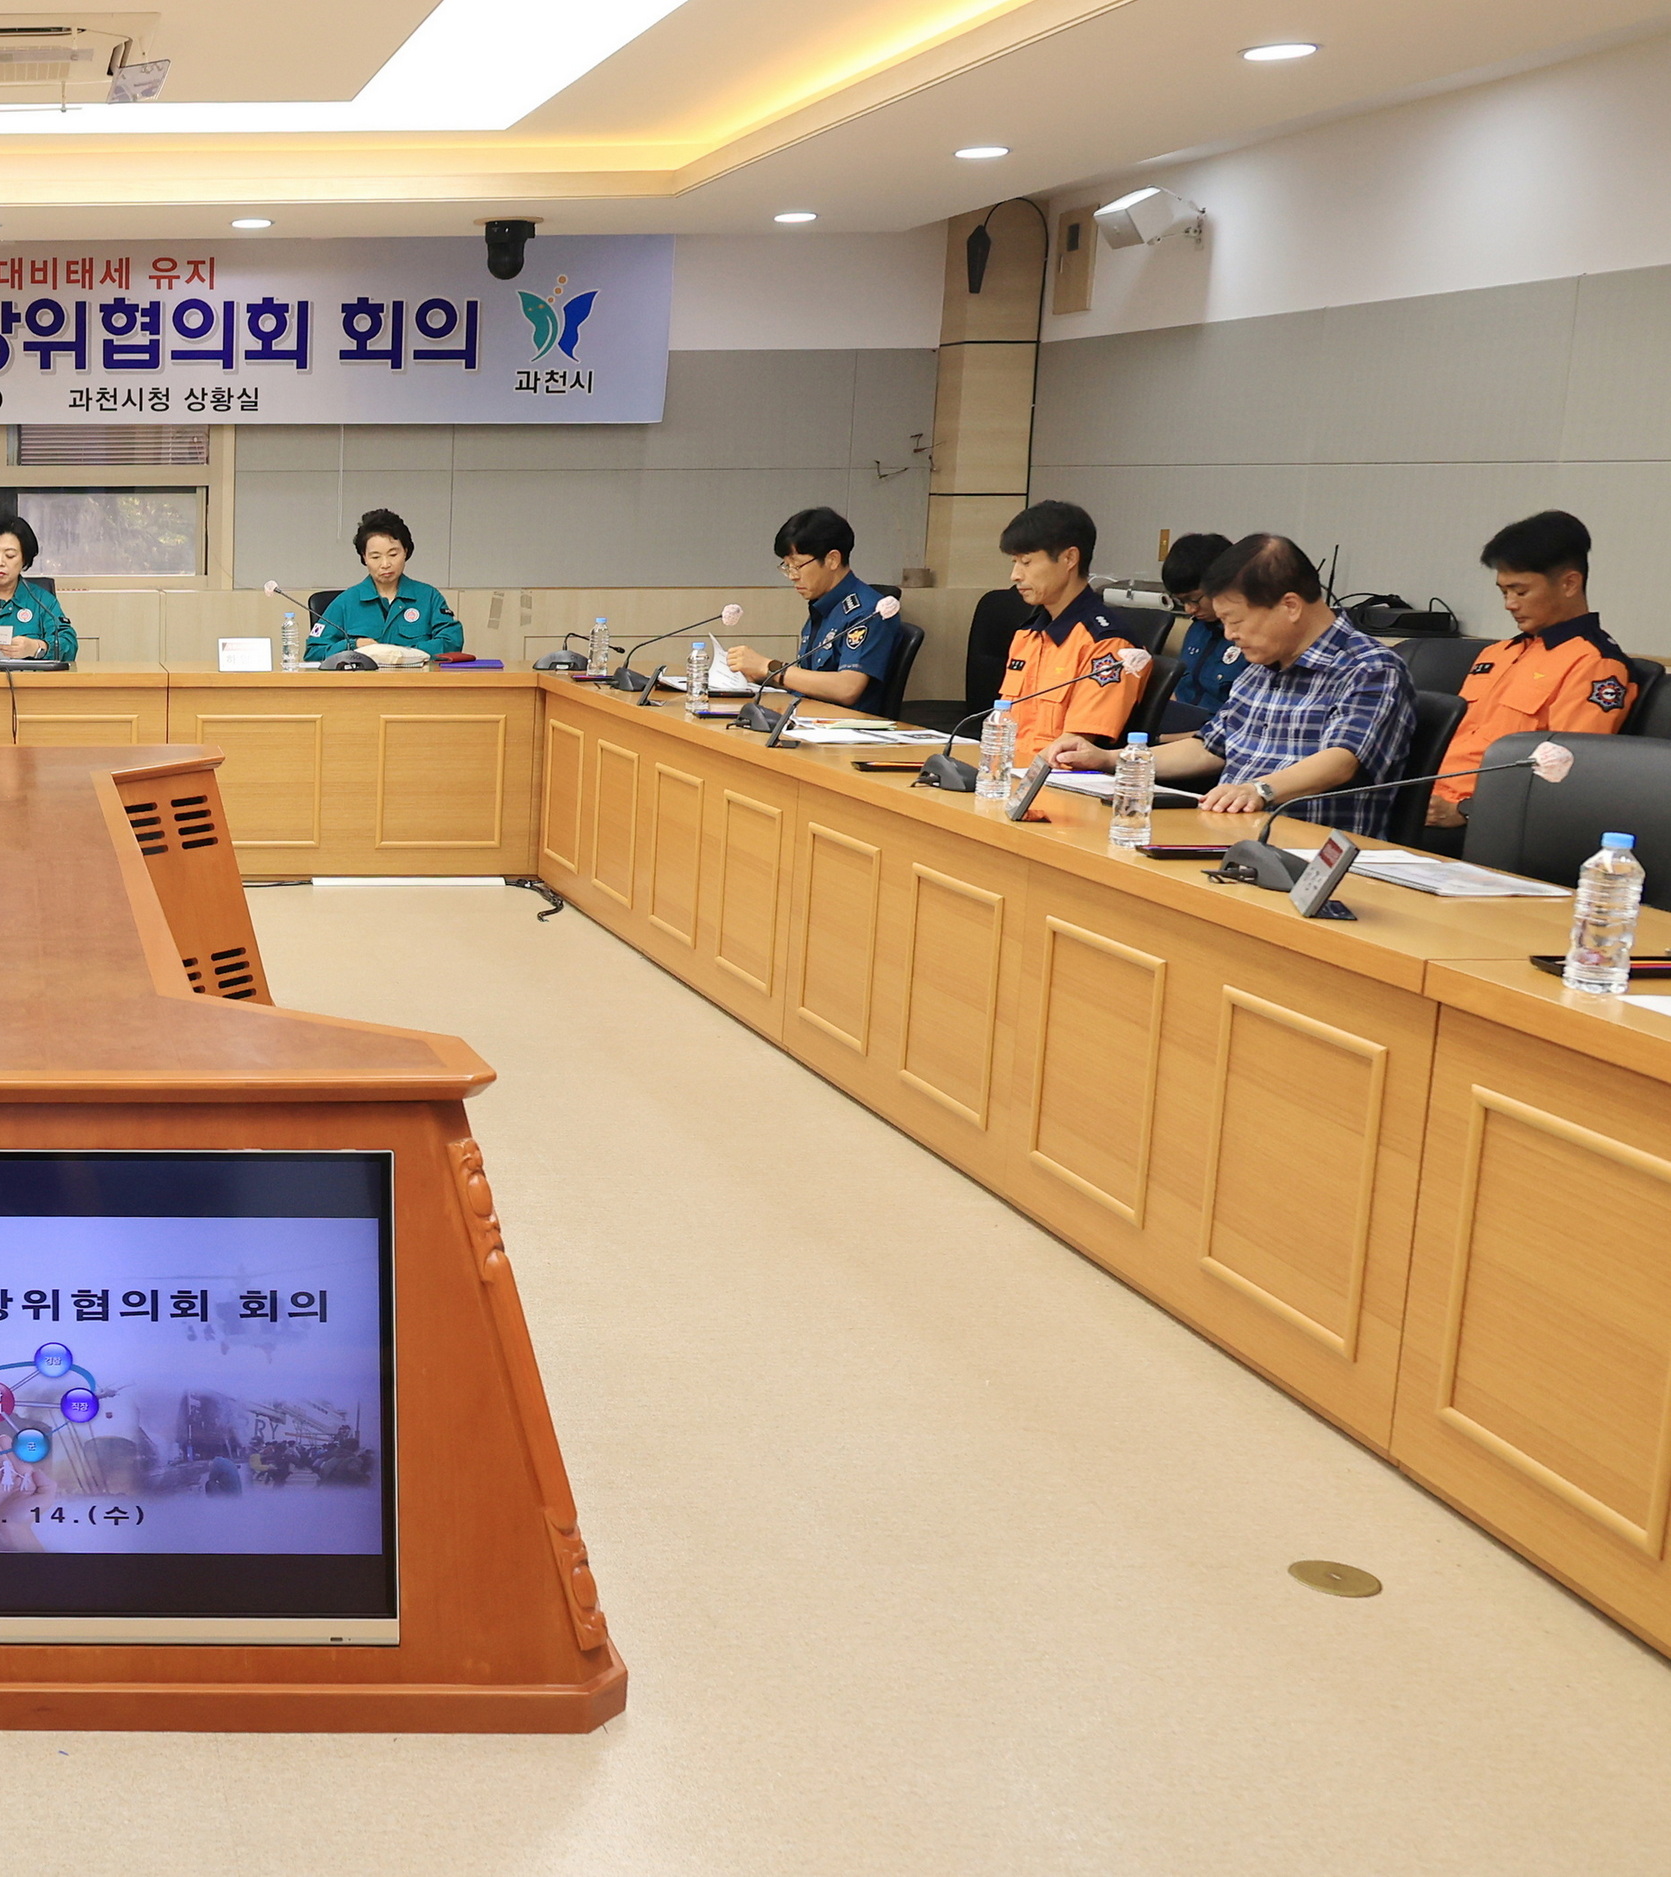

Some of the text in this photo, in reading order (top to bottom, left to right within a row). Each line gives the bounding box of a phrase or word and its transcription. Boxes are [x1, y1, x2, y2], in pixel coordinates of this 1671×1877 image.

[148, 256, 216, 290] 유지
[339, 297, 479, 372] 회의
[514, 368, 594, 395] 과천시
[68, 386, 171, 412] 과천시청
[184, 386, 260, 412] 상황실
[239, 1288, 328, 1323] 회의
[71, 1402, 89, 1412] 직장
[30, 1504, 145, 1527] 14.(수)
